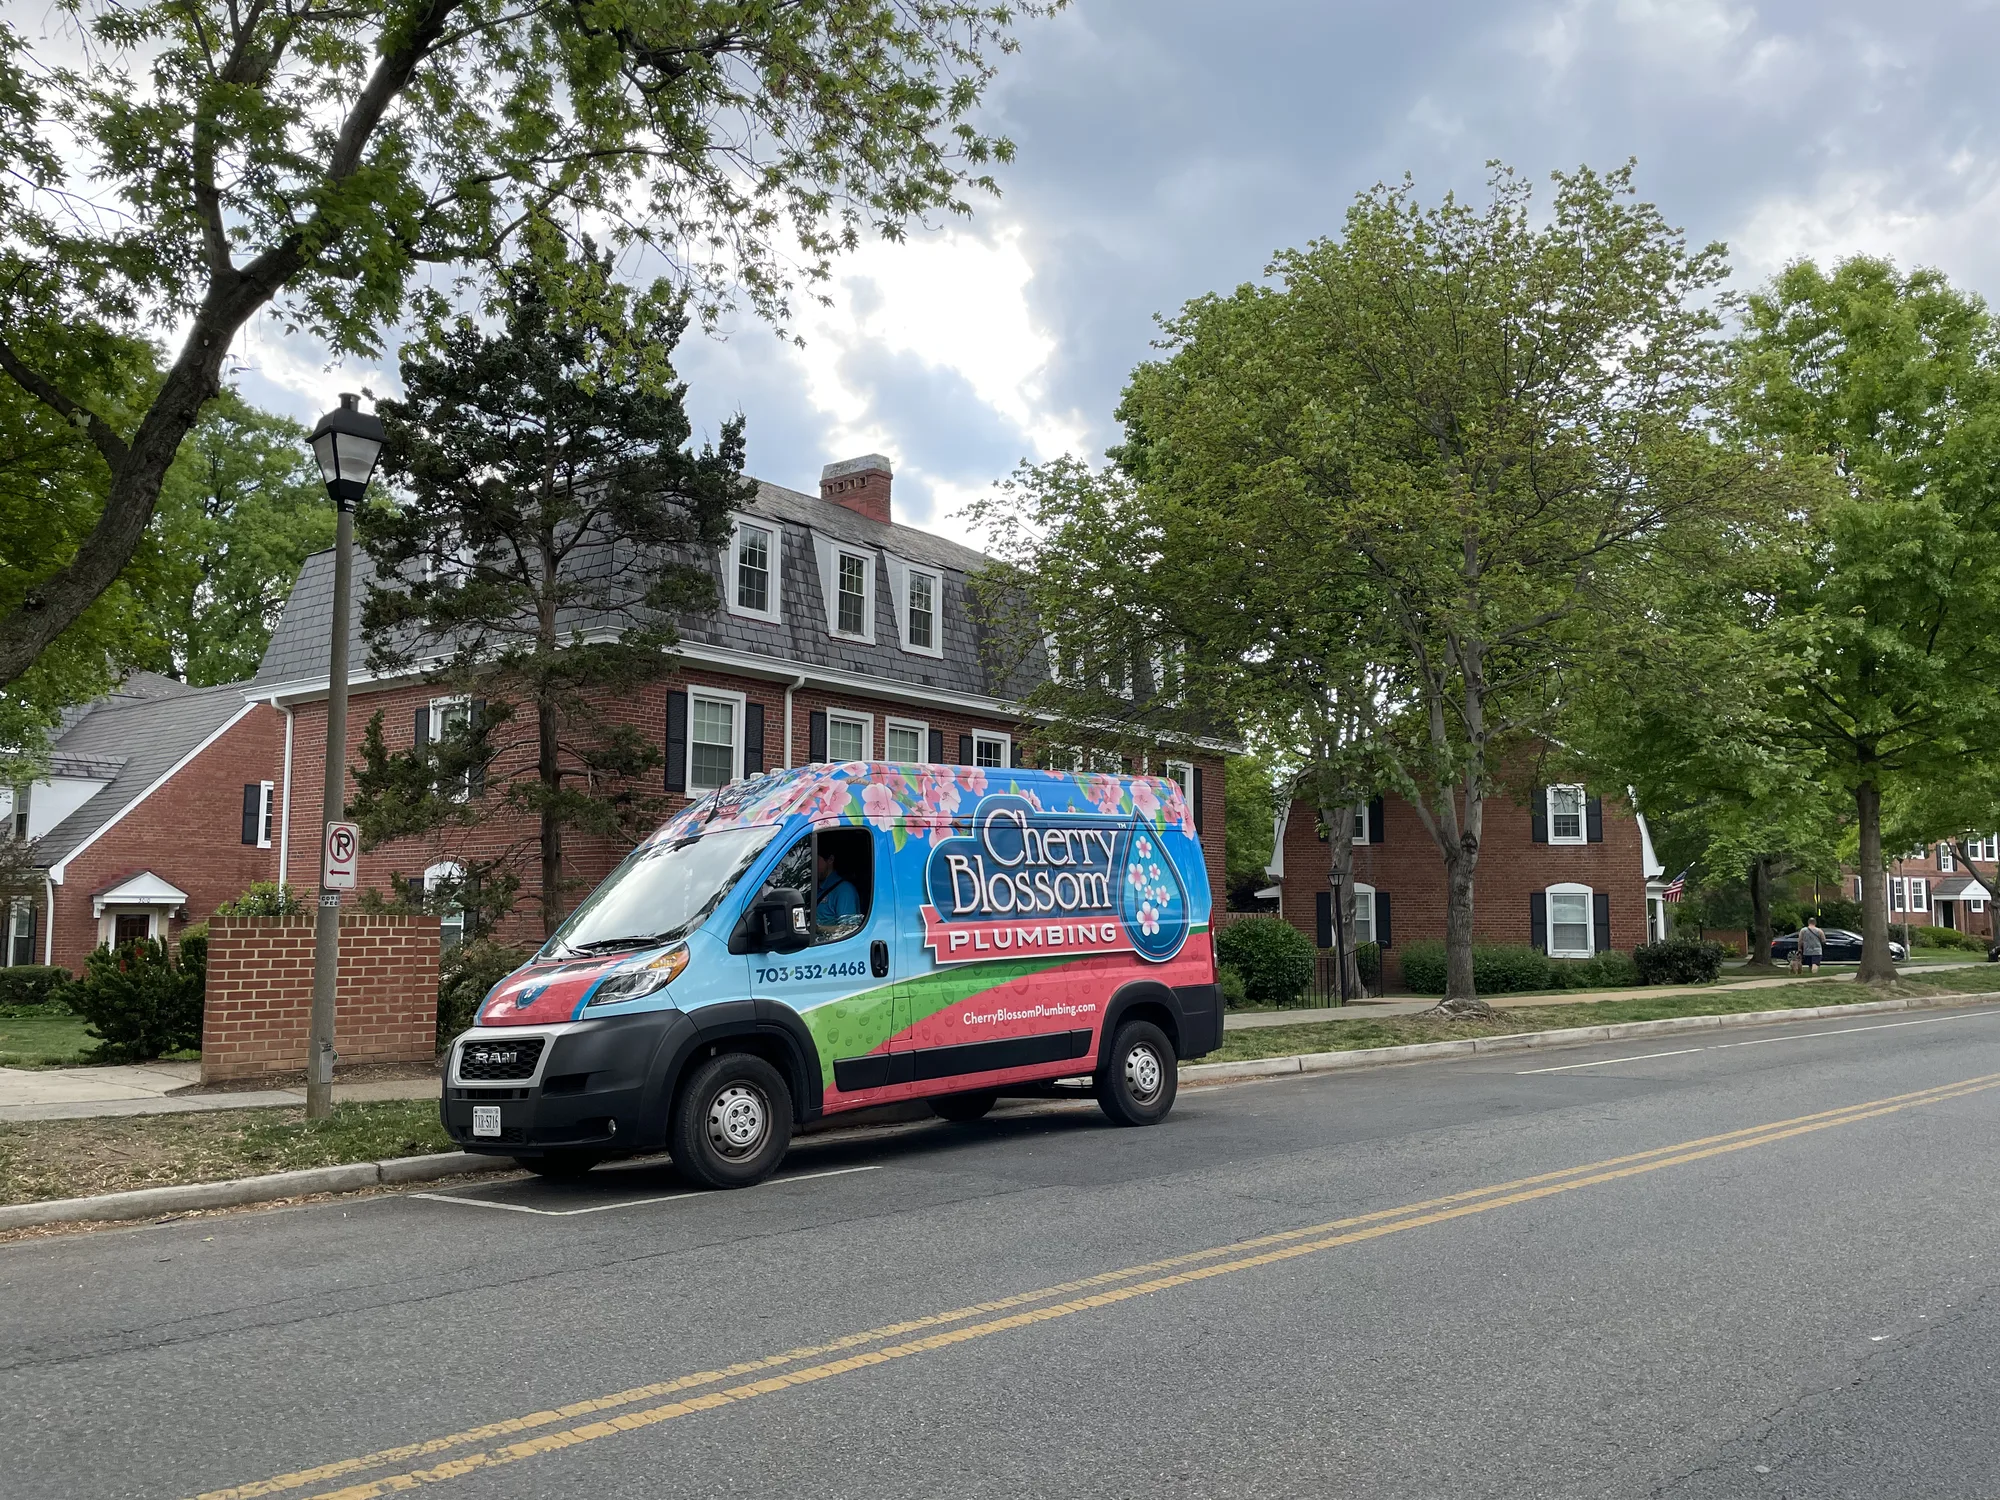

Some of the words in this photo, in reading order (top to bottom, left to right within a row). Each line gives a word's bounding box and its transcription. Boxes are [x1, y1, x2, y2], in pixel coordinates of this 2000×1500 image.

[336, 833, 351, 856] P
[983, 809, 1118, 883] Cherry
[945, 854, 1113, 914] Blossom
[949, 923, 1117, 951] PLUMBING
[963, 1003, 1096, 1025] CherryBlossomPlumbing.com
[475, 1052, 517, 1064] RAM
